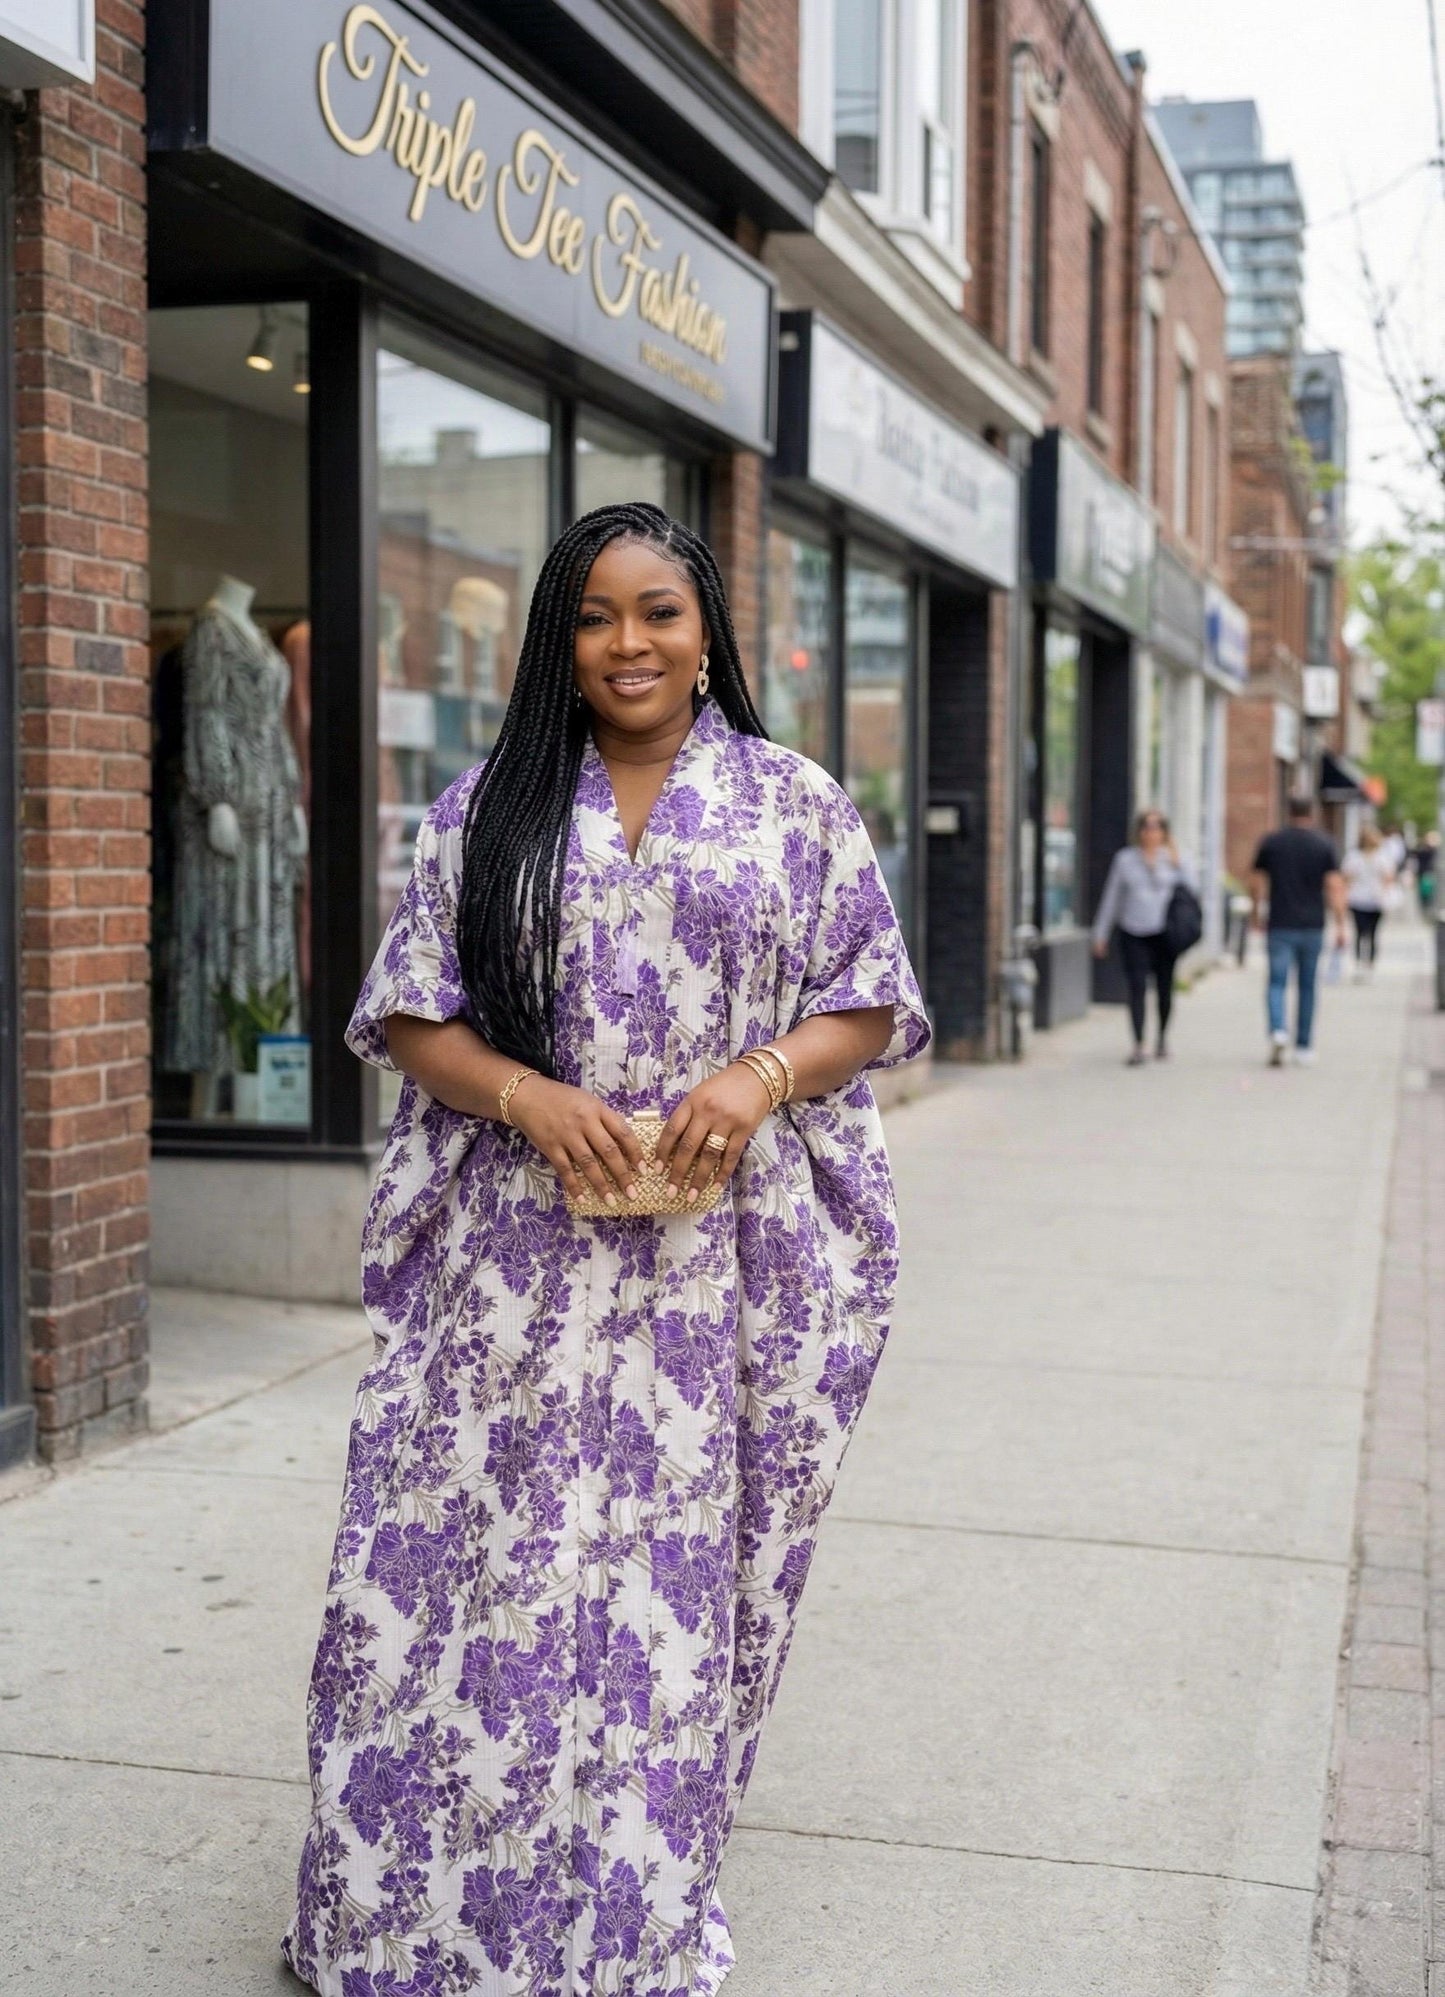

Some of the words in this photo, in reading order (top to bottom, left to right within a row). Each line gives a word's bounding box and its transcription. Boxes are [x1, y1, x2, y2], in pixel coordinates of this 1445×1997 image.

[318, 4, 487, 222] Triple
[497, 129, 585, 275] Tee
[593, 193, 727, 364] Fashion
